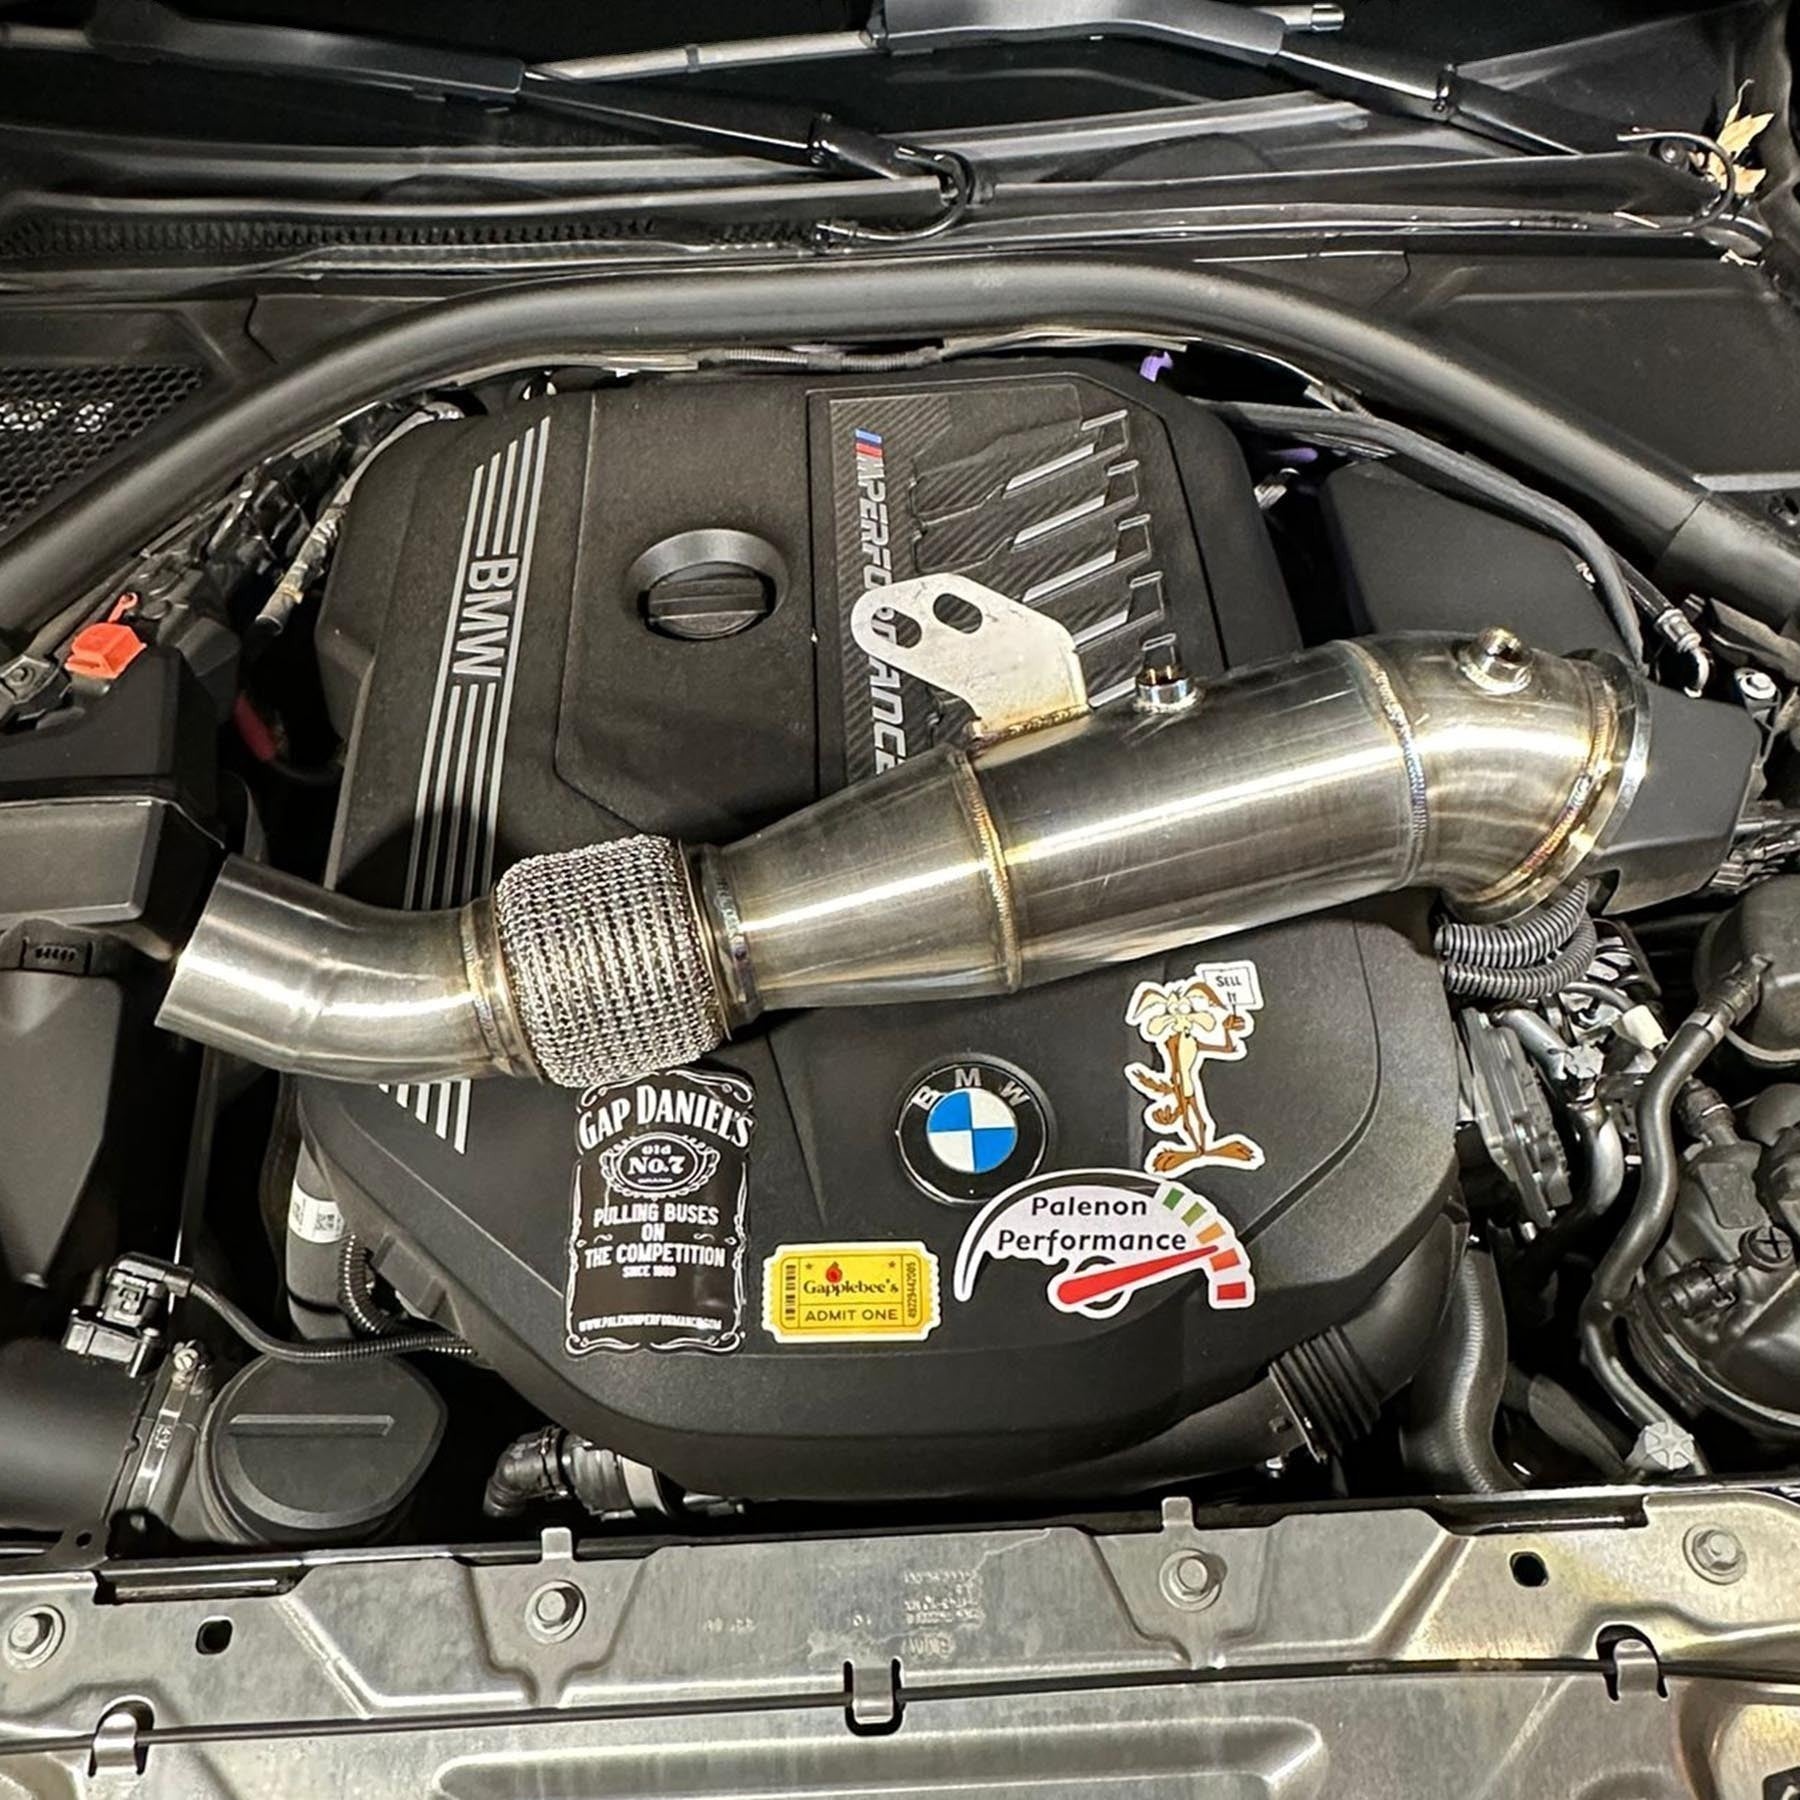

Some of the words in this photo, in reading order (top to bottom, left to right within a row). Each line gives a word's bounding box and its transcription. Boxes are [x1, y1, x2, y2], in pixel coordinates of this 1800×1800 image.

[452, 558, 519, 677] BMW
[1215, 975, 1242, 988] SELL
[1227, 991, 1237, 1003] IT
[911, 1067, 1031, 1111] BMW
[579, 1097, 631, 1150] GAP
[636, 1084, 754, 1149] DANIEL'S
[593, 1203, 659, 1227] PULLING
[664, 1202, 720, 1226] BUSES
[1031, 1196, 1148, 1216] Palenon
[641, 1223, 666, 1242] ON
[998, 1229, 1188, 1257] Performance
[584, 1245, 612, 1269] THE
[615, 1243, 726, 1267] COMPETITION
[802, 1278, 900, 1298] Gapplebee's
[804, 1309, 858, 1322] ADMIT
[862, 1308, 899, 1321] ONE
